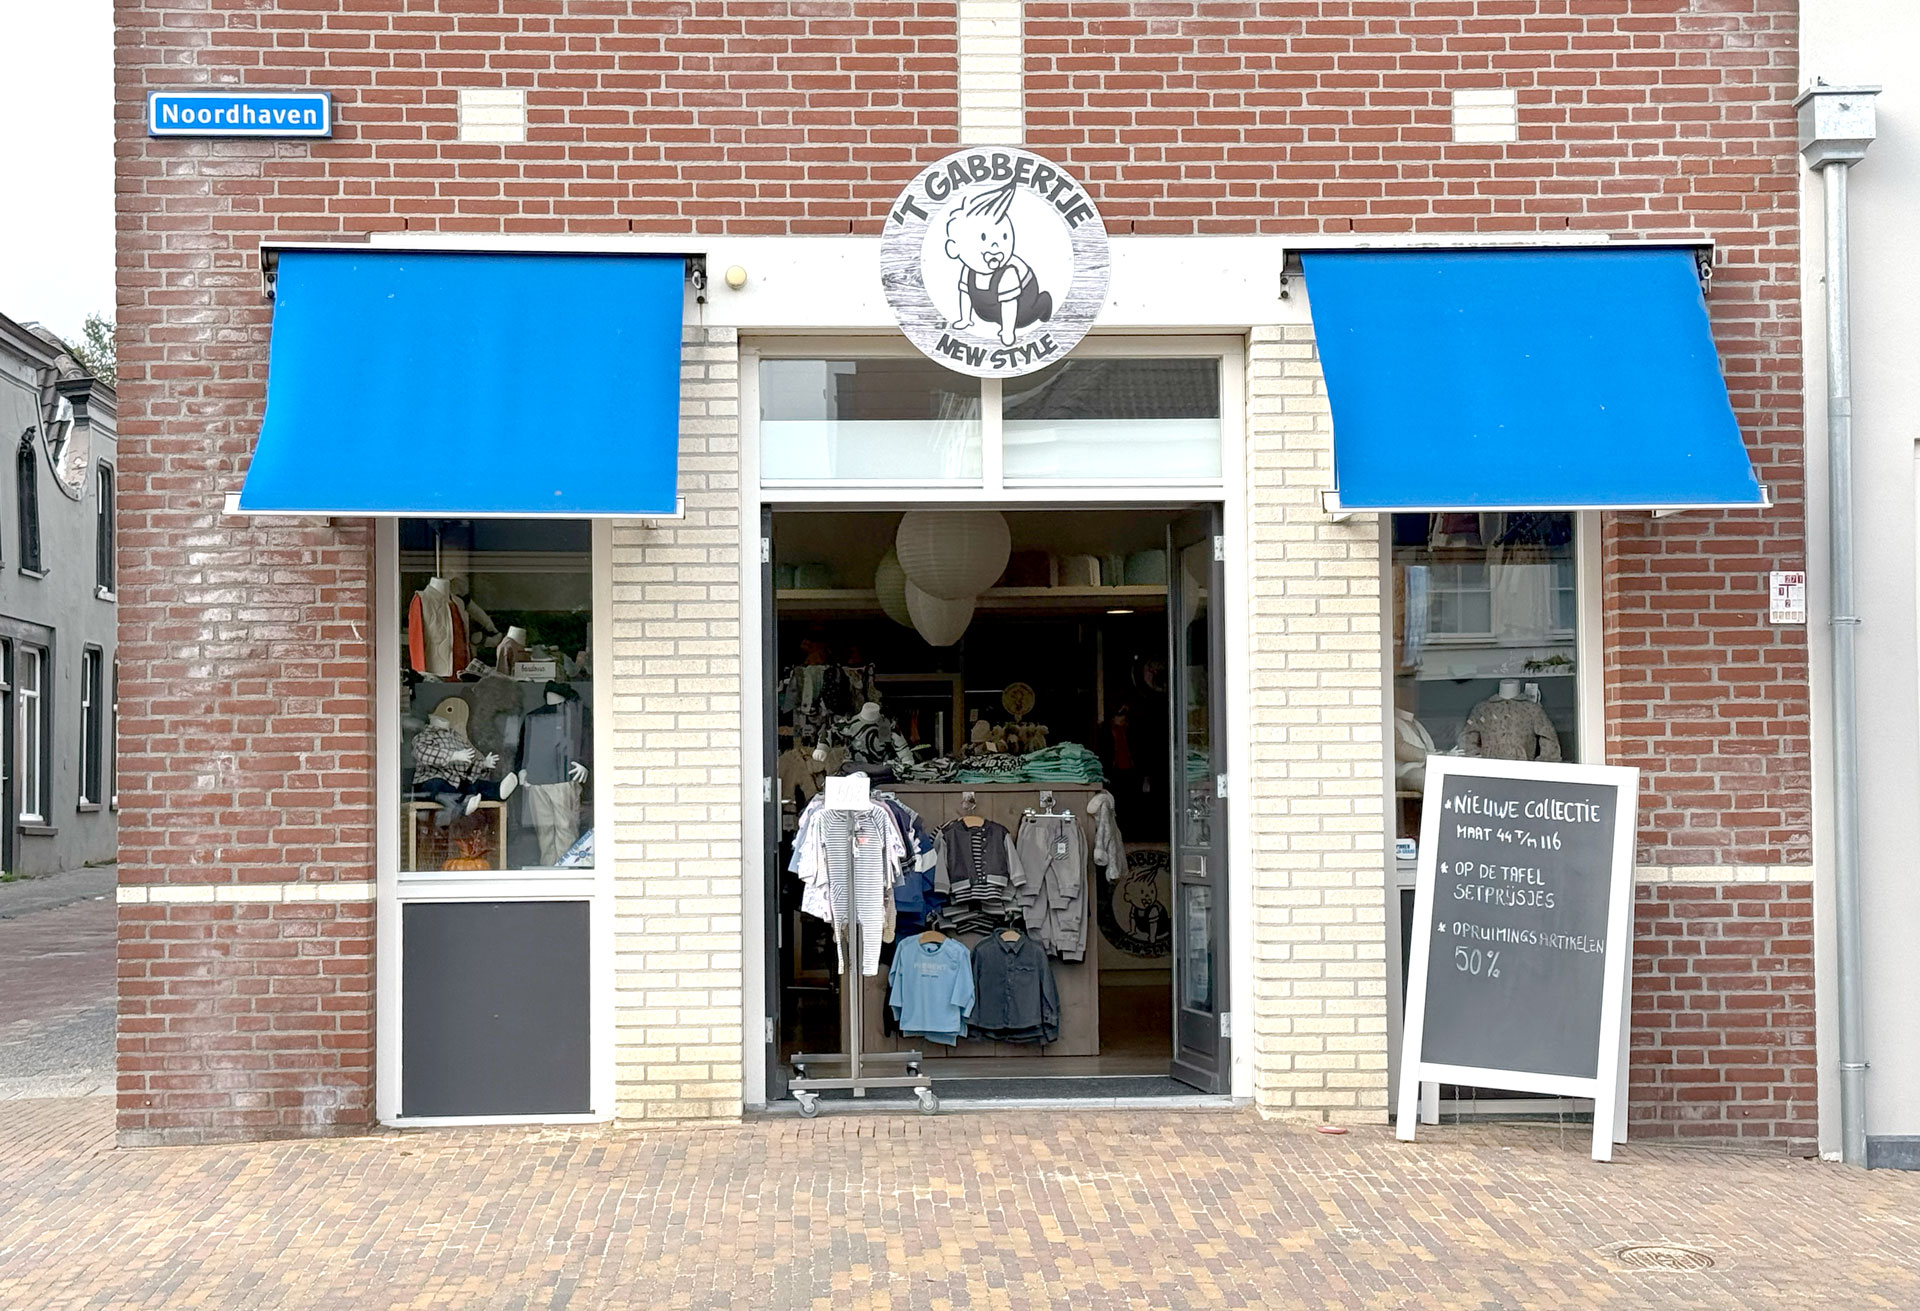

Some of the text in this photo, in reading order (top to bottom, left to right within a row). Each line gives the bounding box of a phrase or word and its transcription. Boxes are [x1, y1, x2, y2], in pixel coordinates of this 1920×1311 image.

[162, 103, 317, 125] Noordhaven
[924, 152, 1095, 230] GABBERTJE
[935, 332, 1060, 369] NEW STYLE
[1454, 790, 1601, 823] NIEUWE COLLECTIE
[1456, 824, 1493, 841] MAAT
[1496, 828, 1512, 843] 44
[1540, 831, 1562, 850] 116
[1455, 861, 1546, 886] OP DE TAFEL
